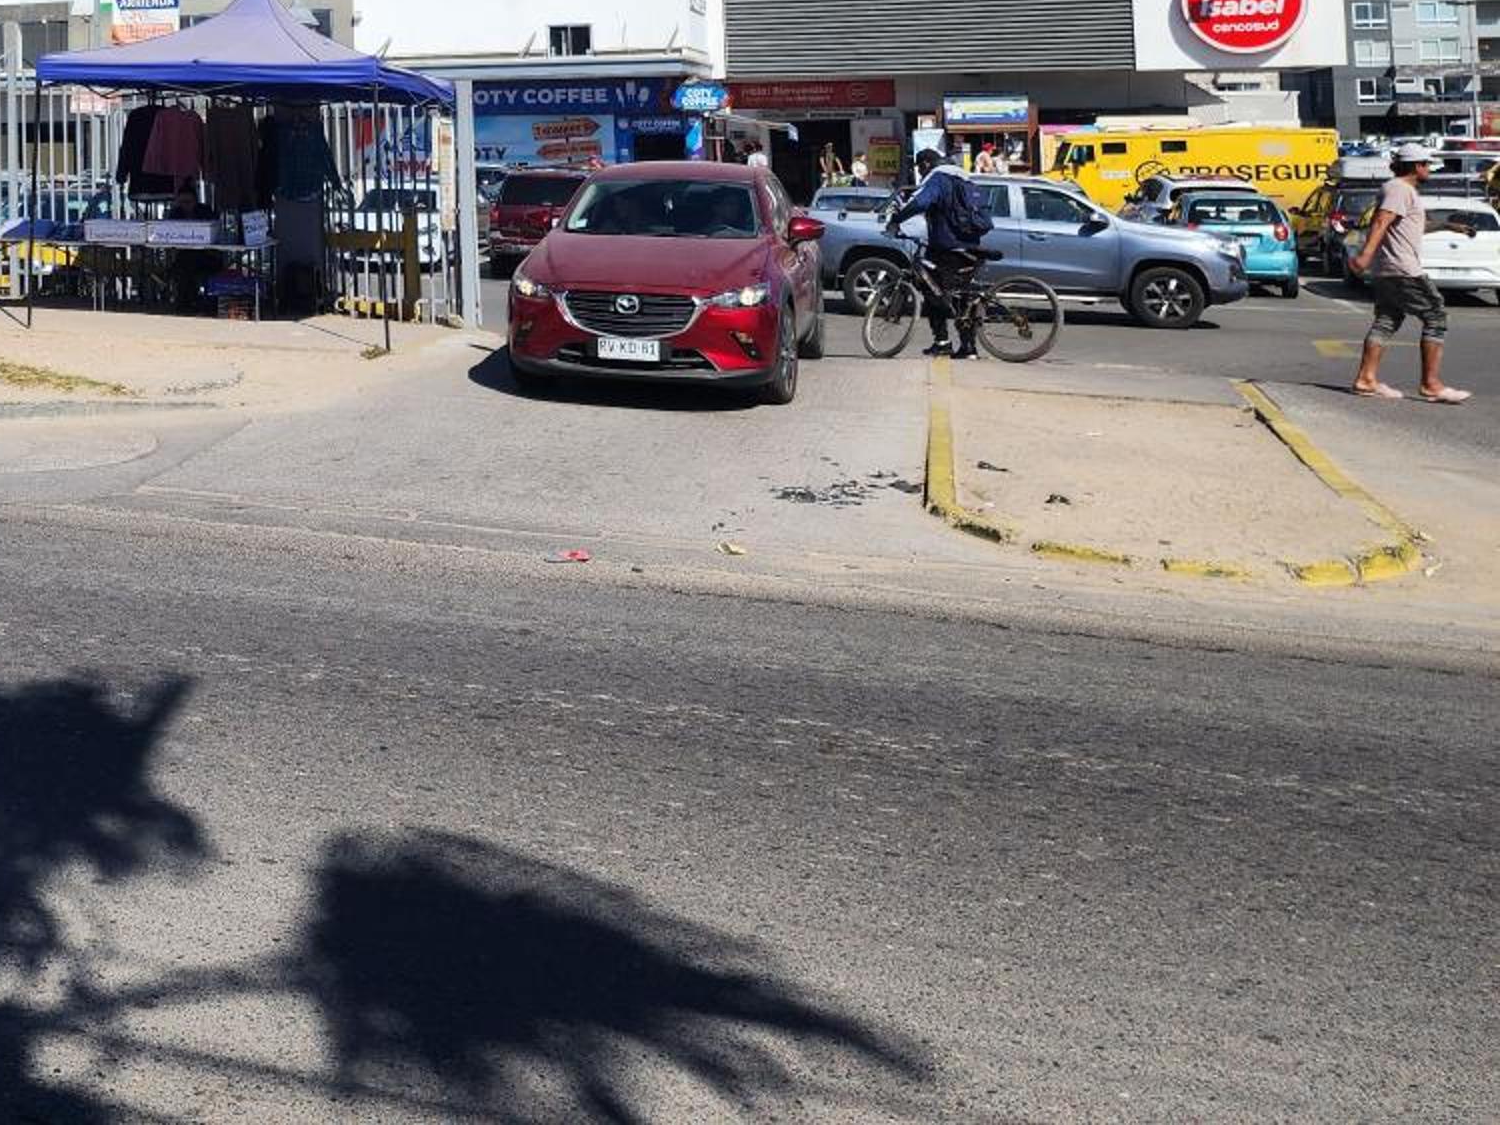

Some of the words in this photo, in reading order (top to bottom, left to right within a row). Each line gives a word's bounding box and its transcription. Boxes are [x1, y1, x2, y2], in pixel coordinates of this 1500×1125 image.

[1211, 18, 1280, 32] cencosud
[473, 89, 517, 104] OTY
[523, 87, 608, 105] COFFEE
[1178, 163, 1333, 182] PROSEGUR
